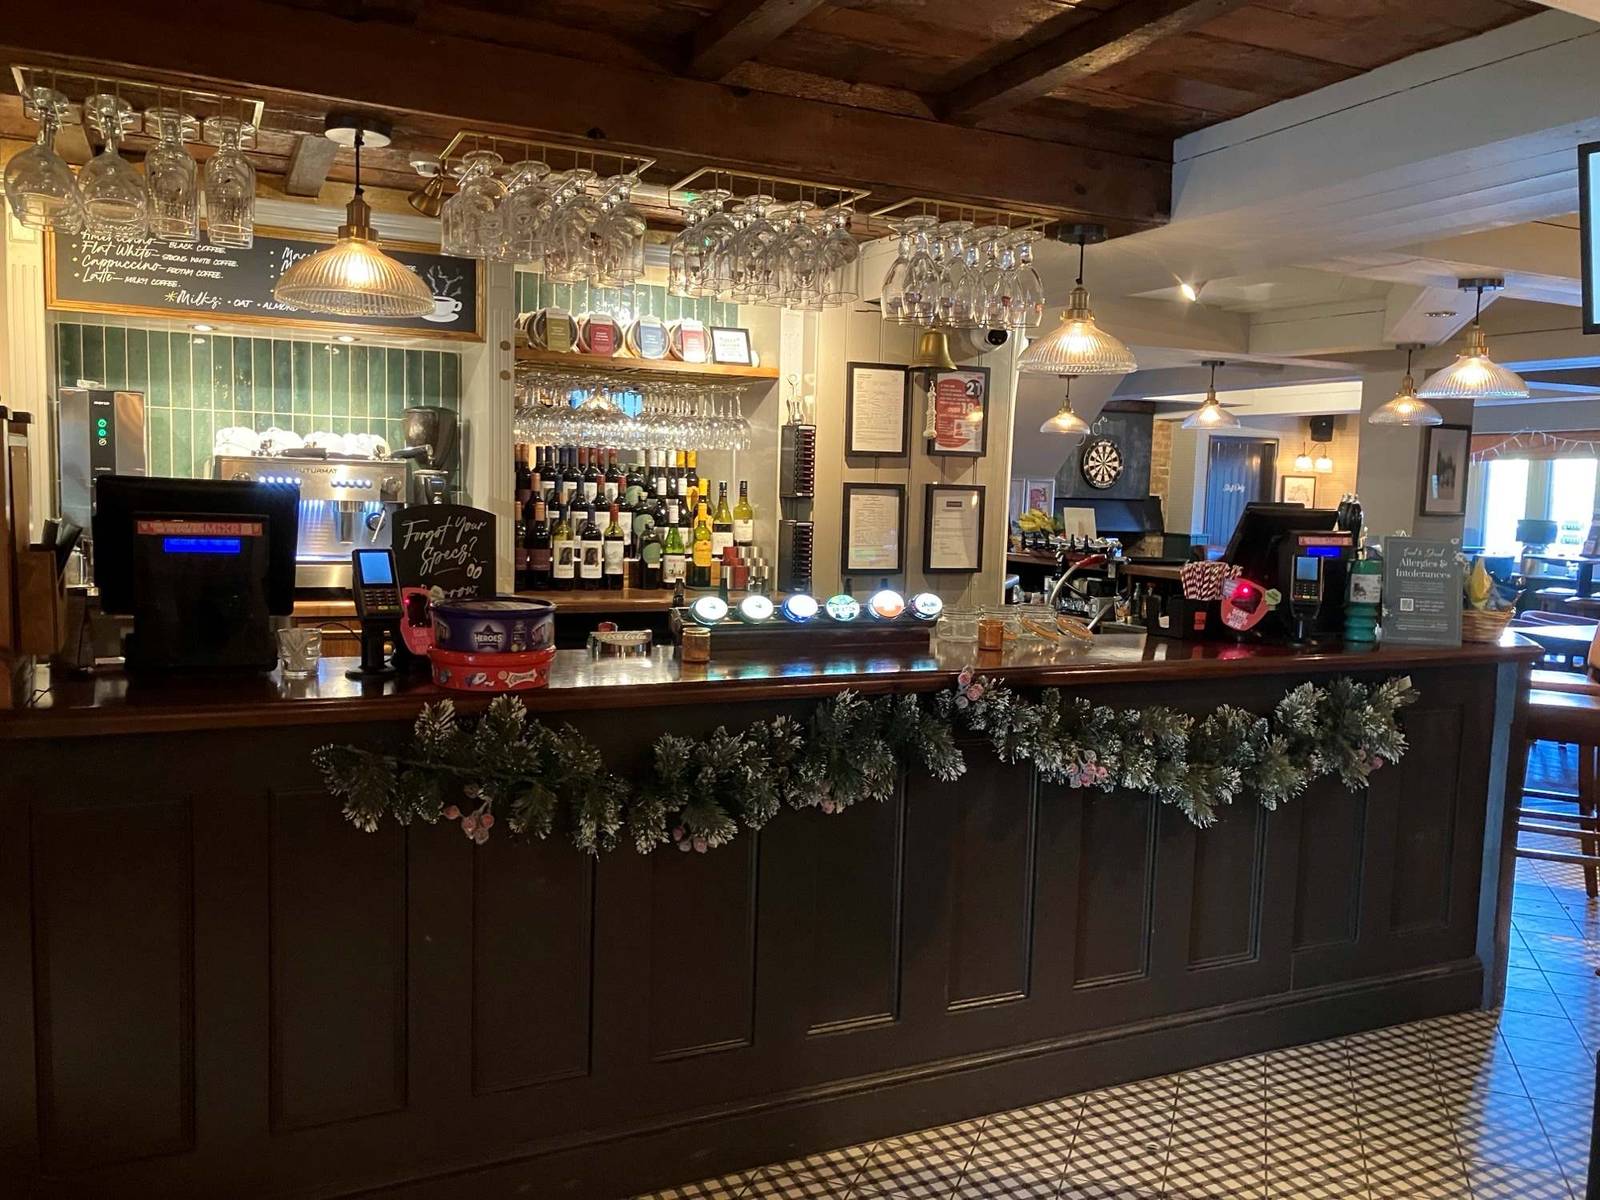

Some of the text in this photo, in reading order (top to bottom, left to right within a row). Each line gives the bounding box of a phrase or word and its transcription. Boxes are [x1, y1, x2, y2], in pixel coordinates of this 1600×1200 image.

[81, 240, 116, 256] Flat
[115, 243, 158, 260] White
[168, 242, 193, 250] BLACK
[81, 254, 161, 272] Cappuccino
[82, 267, 116, 283] Latte
[124, 276, 148, 285] MILKY
[233, 299, 253, 308] OAT
[966, 382, 982, 395] 21
[961, 402, 974, 414] 18
[401, 516, 487, 550] Forgot Your
[420, 536, 478, 576] Specs?
[1401, 558, 1437, 569] Allergies
[1395, 568, 1451, 578] Intolerances
[474, 634, 503, 643] HEROES
